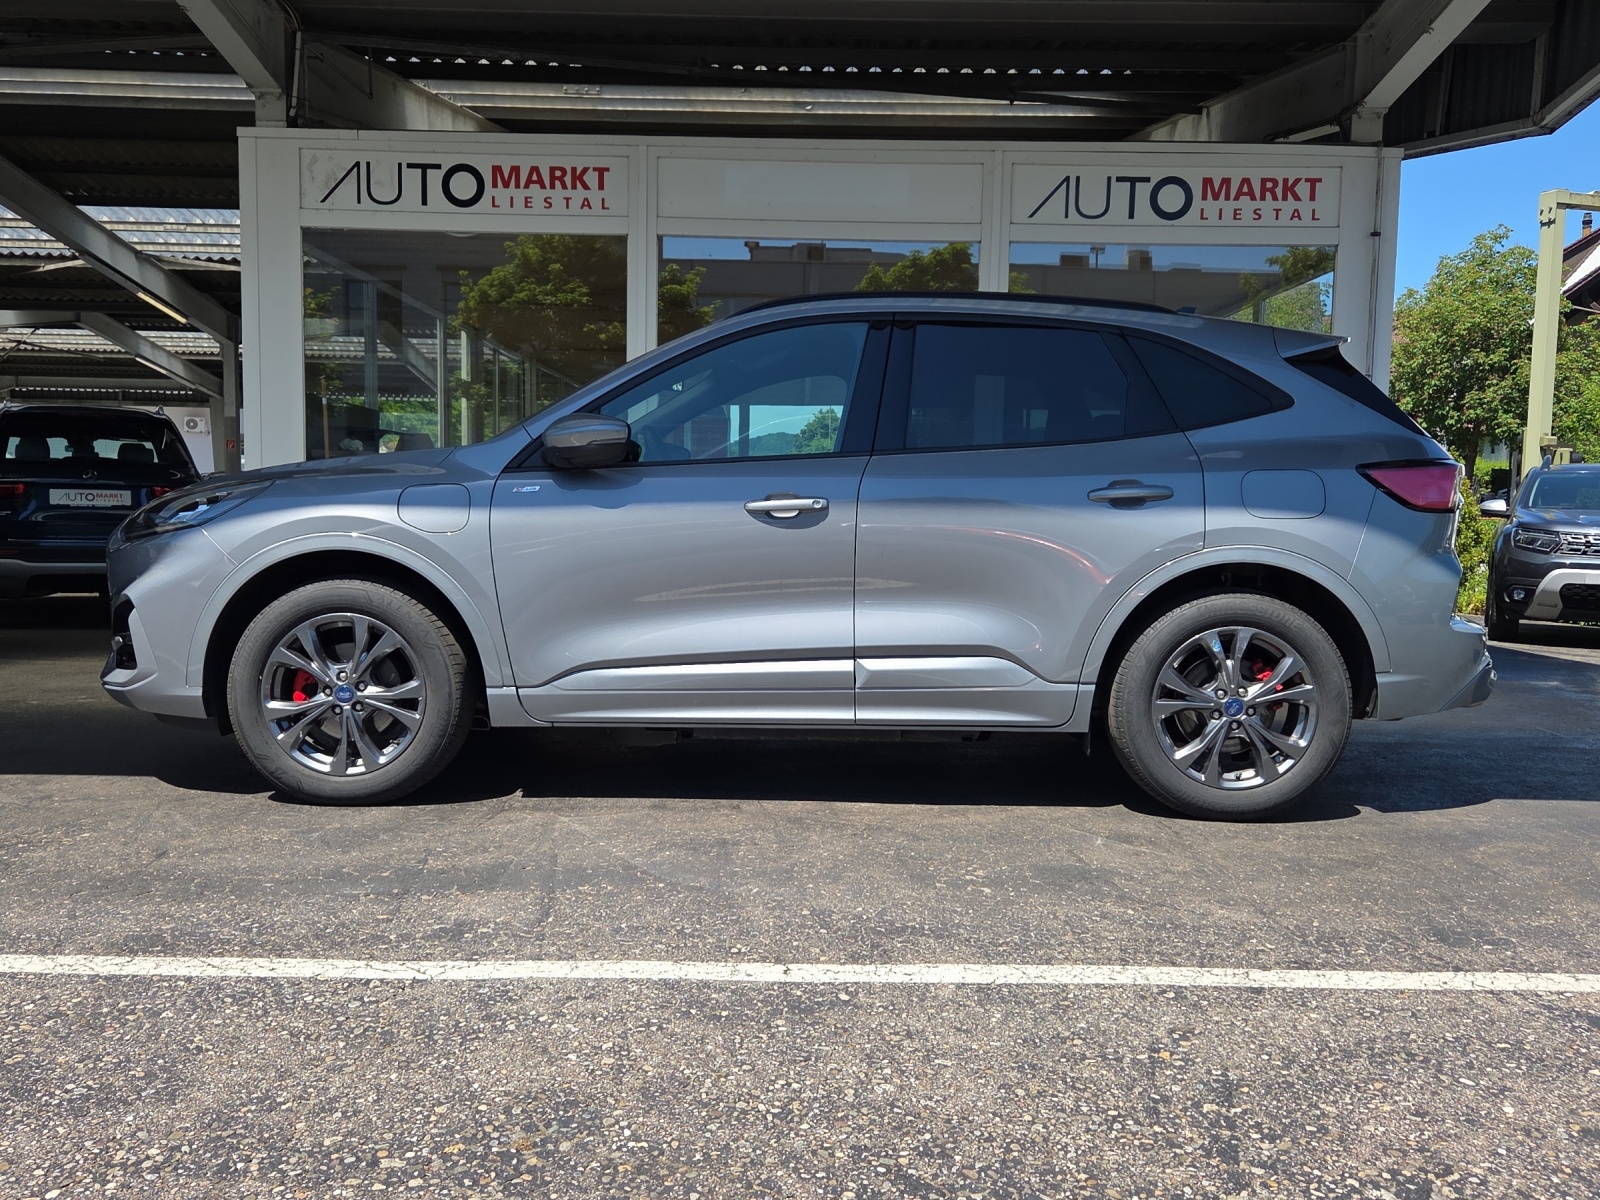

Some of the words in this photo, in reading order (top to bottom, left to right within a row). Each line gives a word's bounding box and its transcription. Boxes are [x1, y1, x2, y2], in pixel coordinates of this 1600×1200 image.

[319, 160, 486, 208] AUTO
[490, 164, 611, 191] MARKT
[490, 195, 610, 210] LIESTAL
[1027, 175, 1194, 221] AUTO
[1200, 176, 1323, 202] MARKT
[1199, 207, 1321, 221] LIESTAL
[58, 492, 95, 502] AUTO
